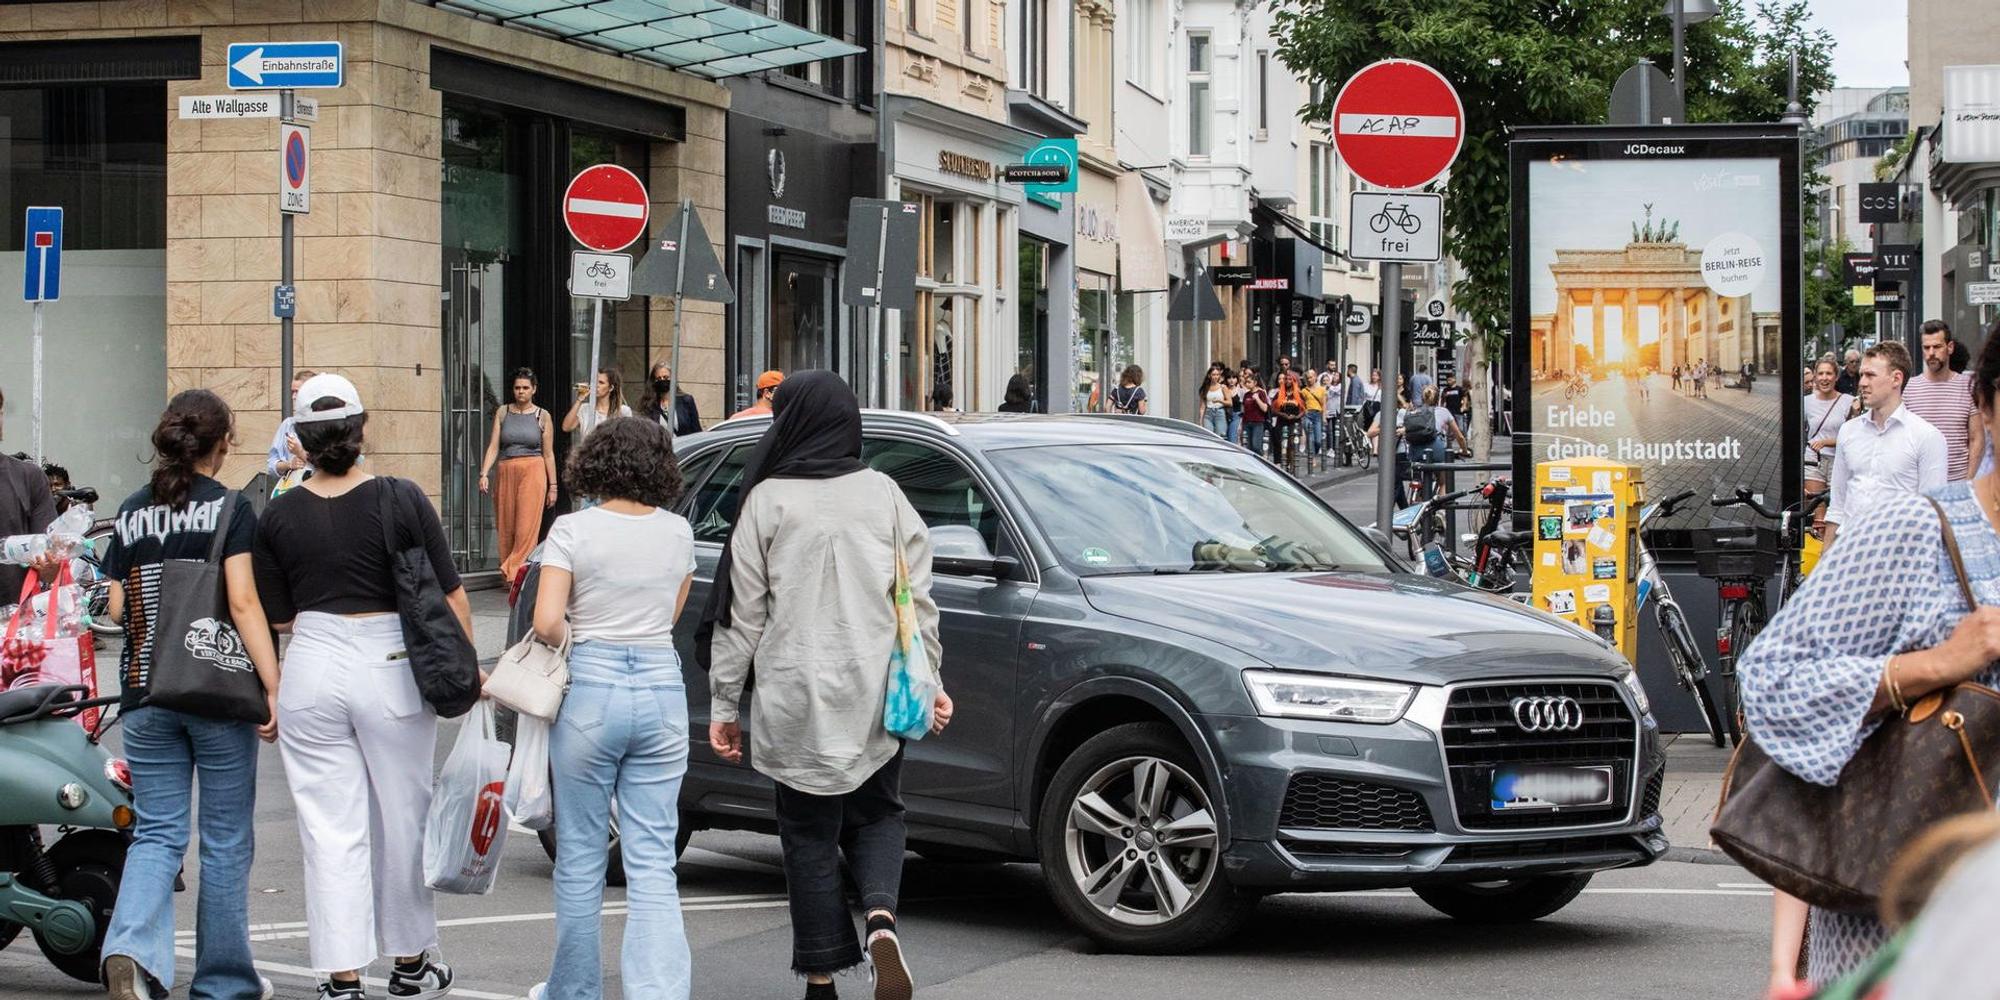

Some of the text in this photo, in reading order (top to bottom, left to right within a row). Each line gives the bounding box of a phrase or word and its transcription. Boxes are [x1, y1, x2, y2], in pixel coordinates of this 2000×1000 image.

[262, 60, 334, 71] Einbahnstraße
[191, 99, 268, 117] Alte Wallgasse
[1623, 144, 1685, 155] JCDecaux
[287, 192, 303, 208] ZONE
[1862, 197, 1896, 209] COS
[1381, 237, 1409, 252] frei
[1705, 257, 1762, 271] BERLIN-REISE
[1883, 255, 1910, 265] VIU
[1721, 273, 1748, 283] buchen
[1547, 405, 1616, 428] Erlebe
[1547, 436, 1741, 465] deine Hauptstadt
